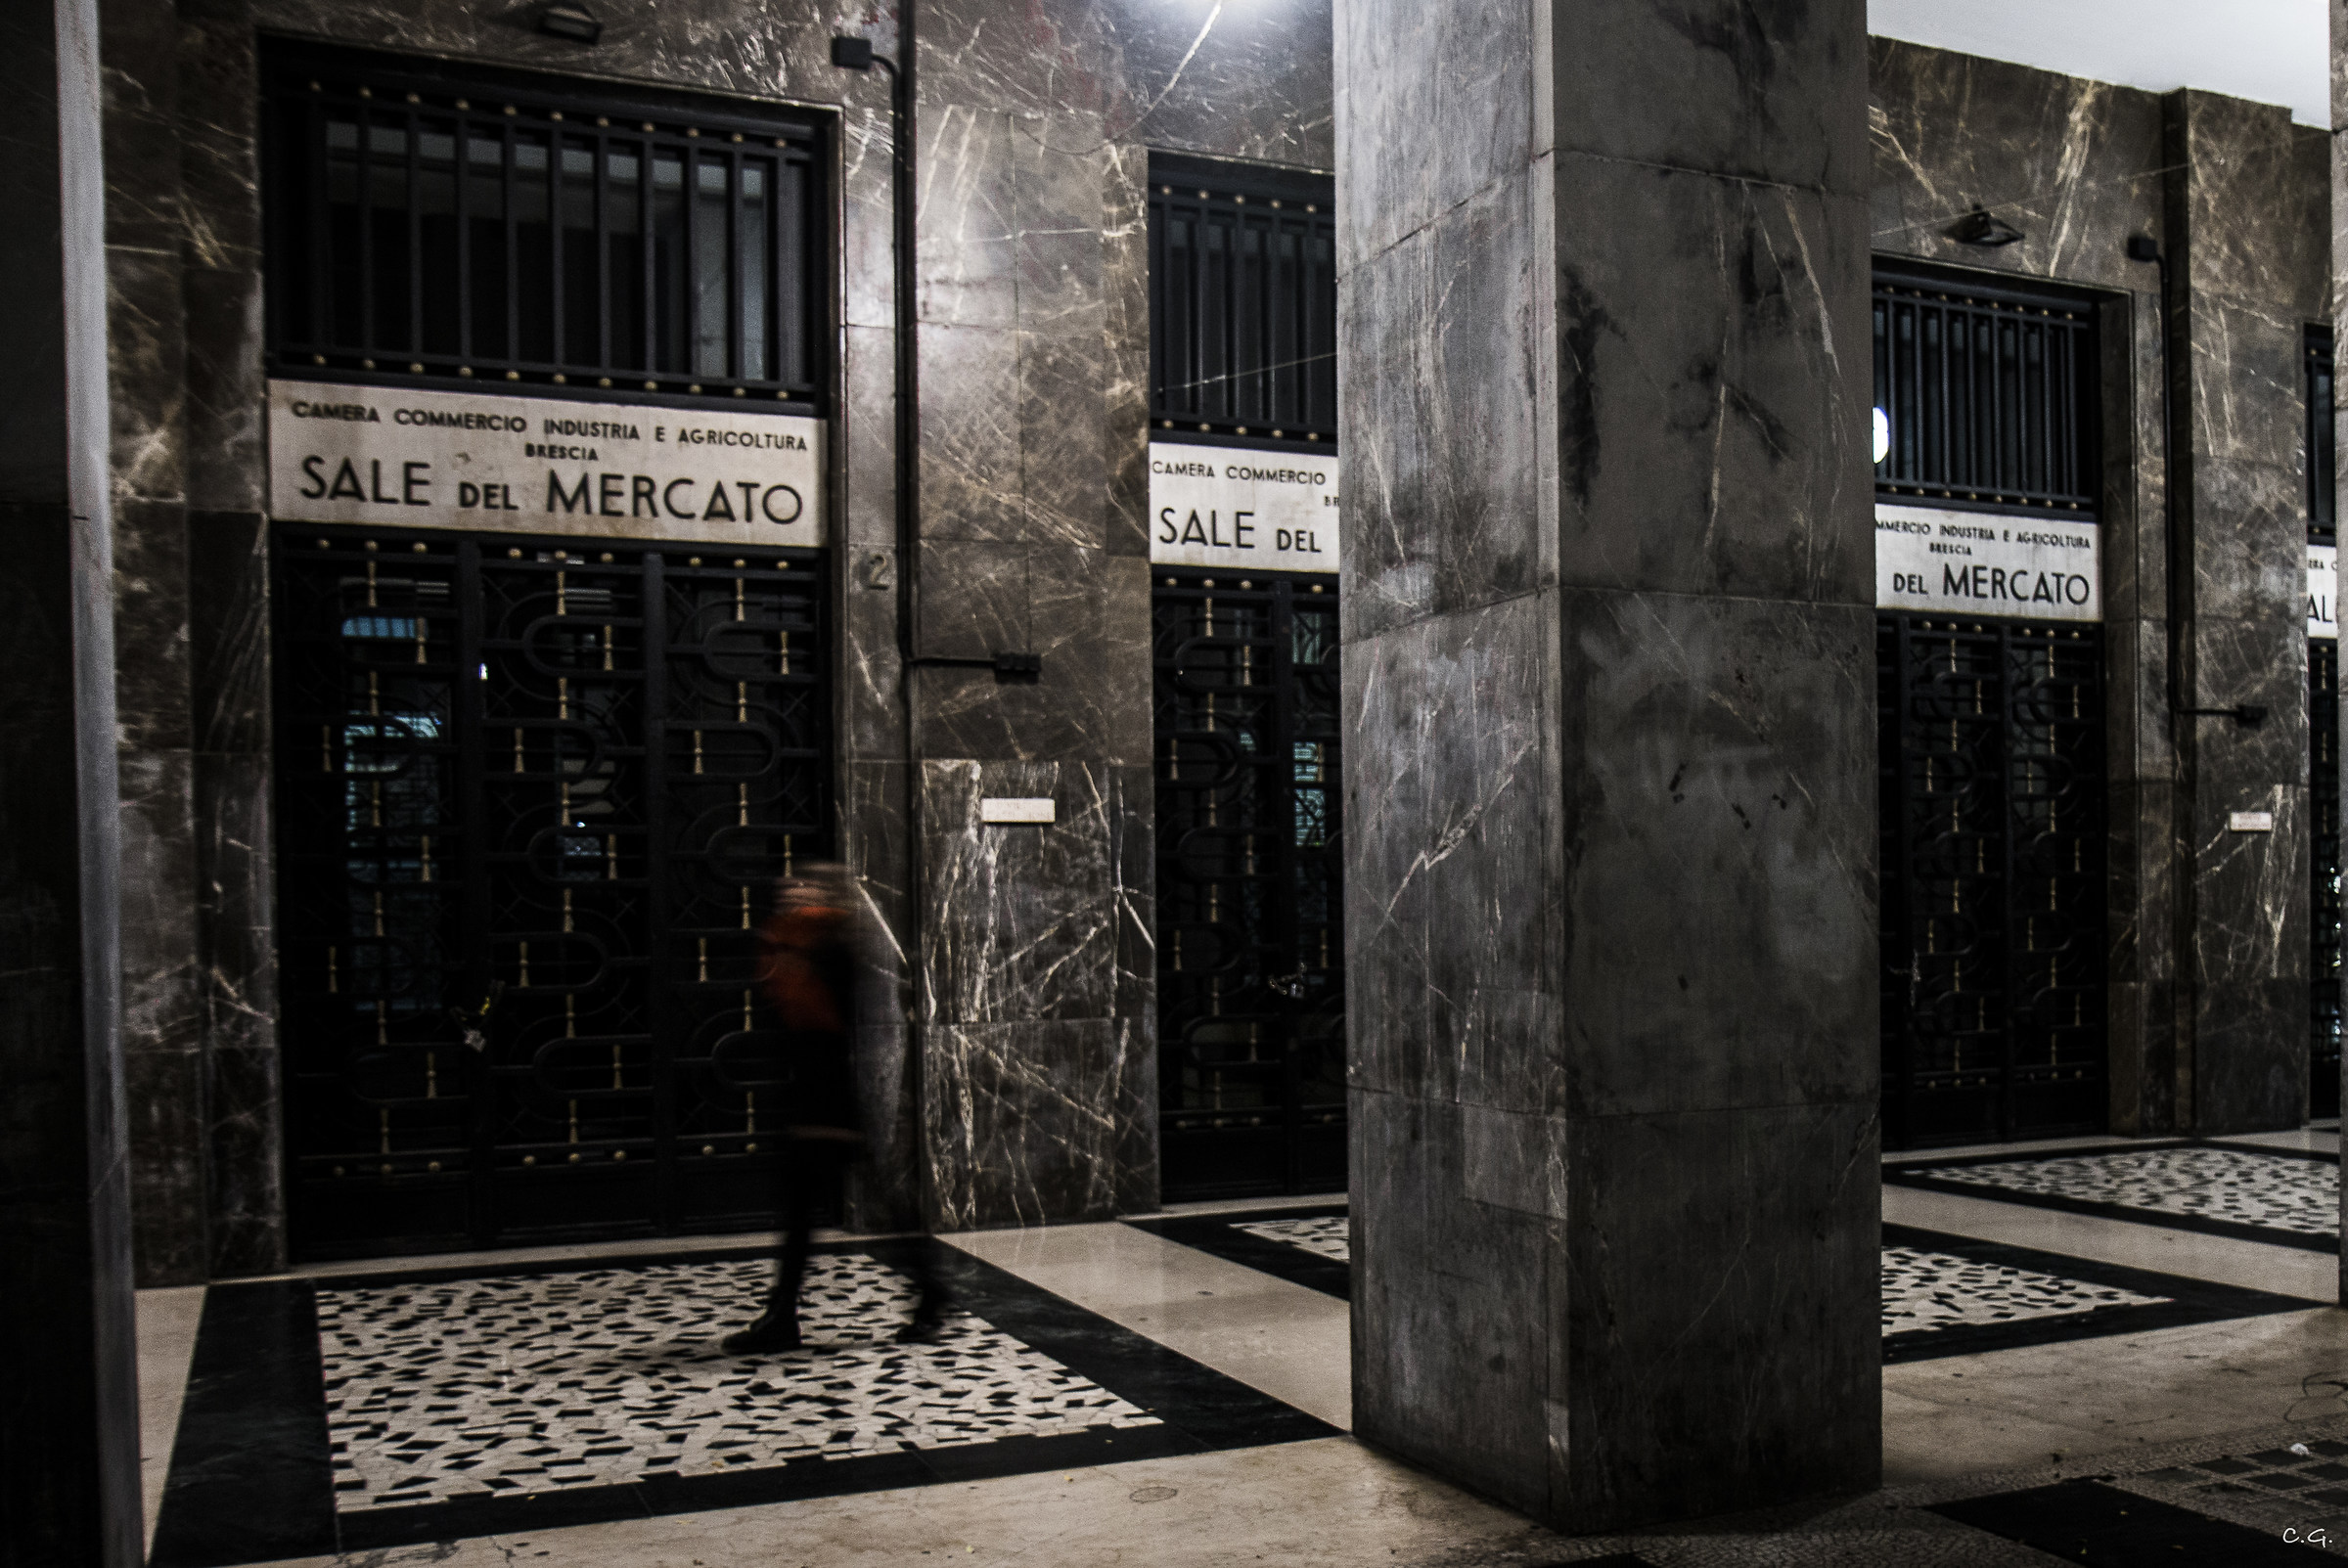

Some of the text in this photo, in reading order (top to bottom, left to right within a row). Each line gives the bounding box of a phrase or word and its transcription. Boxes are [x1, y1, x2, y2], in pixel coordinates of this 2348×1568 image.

[293, 400, 808, 451] CAMERA COMMERCIO INDUSTRIA E AGRICOLTURA
[525, 443, 598, 461] BRESCIA
[299, 455, 803, 525] SALE DEL MERCATO
[1151, 460, 1326, 486] CAMERA COMMERCIO
[1158, 507, 1322, 554] SALE DEL
[1939, 523, 1996, 541] INDUSTRIA
[2003, 529, 2009, 543] E
[2016, 531, 2091, 550] AGRICOLTURA
[1929, 542, 1972, 557] BRESCIA
[867, 554, 889, 591] 2
[1893, 561, 2091, 605] DEL MERCATO
